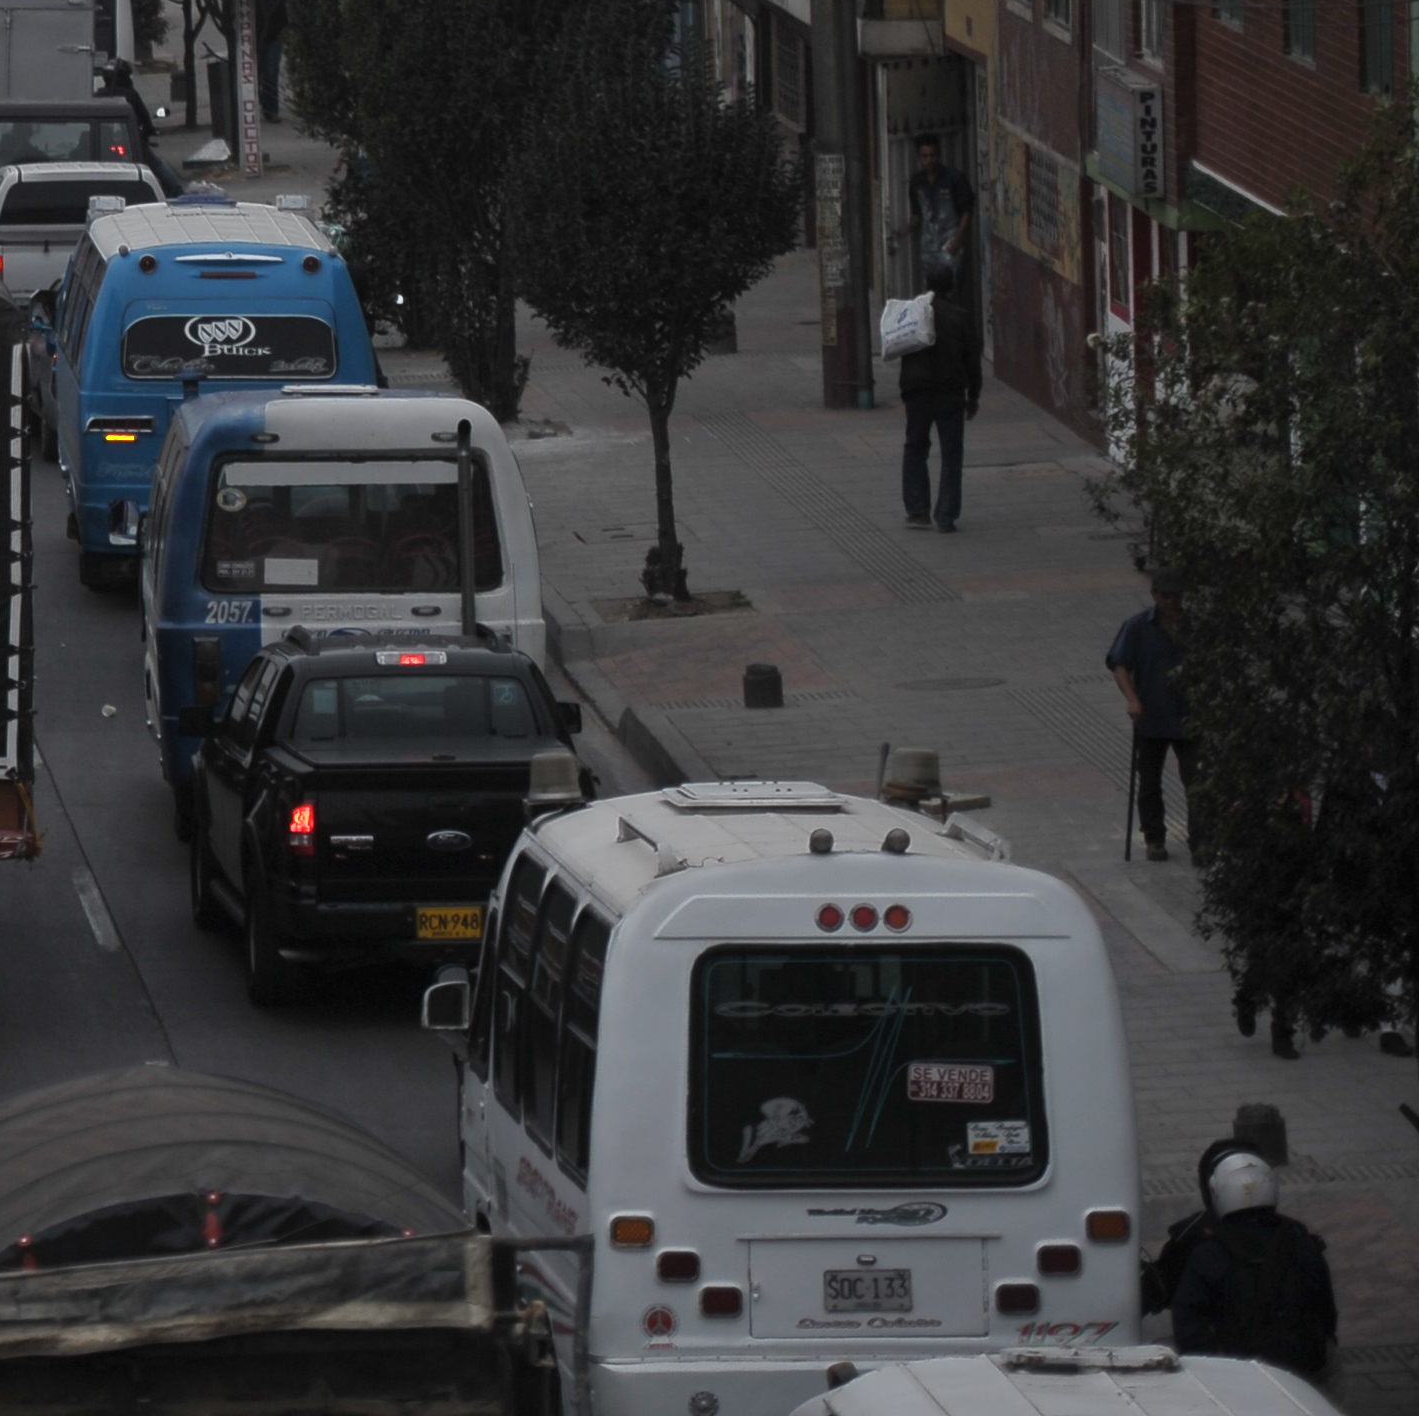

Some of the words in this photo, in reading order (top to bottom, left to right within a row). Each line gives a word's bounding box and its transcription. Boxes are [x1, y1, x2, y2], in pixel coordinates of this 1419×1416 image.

[1139, 91, 1158, 194] PINTURAS
[300, 605, 404, 623] PERMOGAL
[419, 913, 480, 931] RCN-948
[913, 1067, 933, 1081] SE
[938, 1067, 990, 1083] VENDE
[919, 1081, 938, 1097] 314
[940, 1082, 960, 1099] 337
